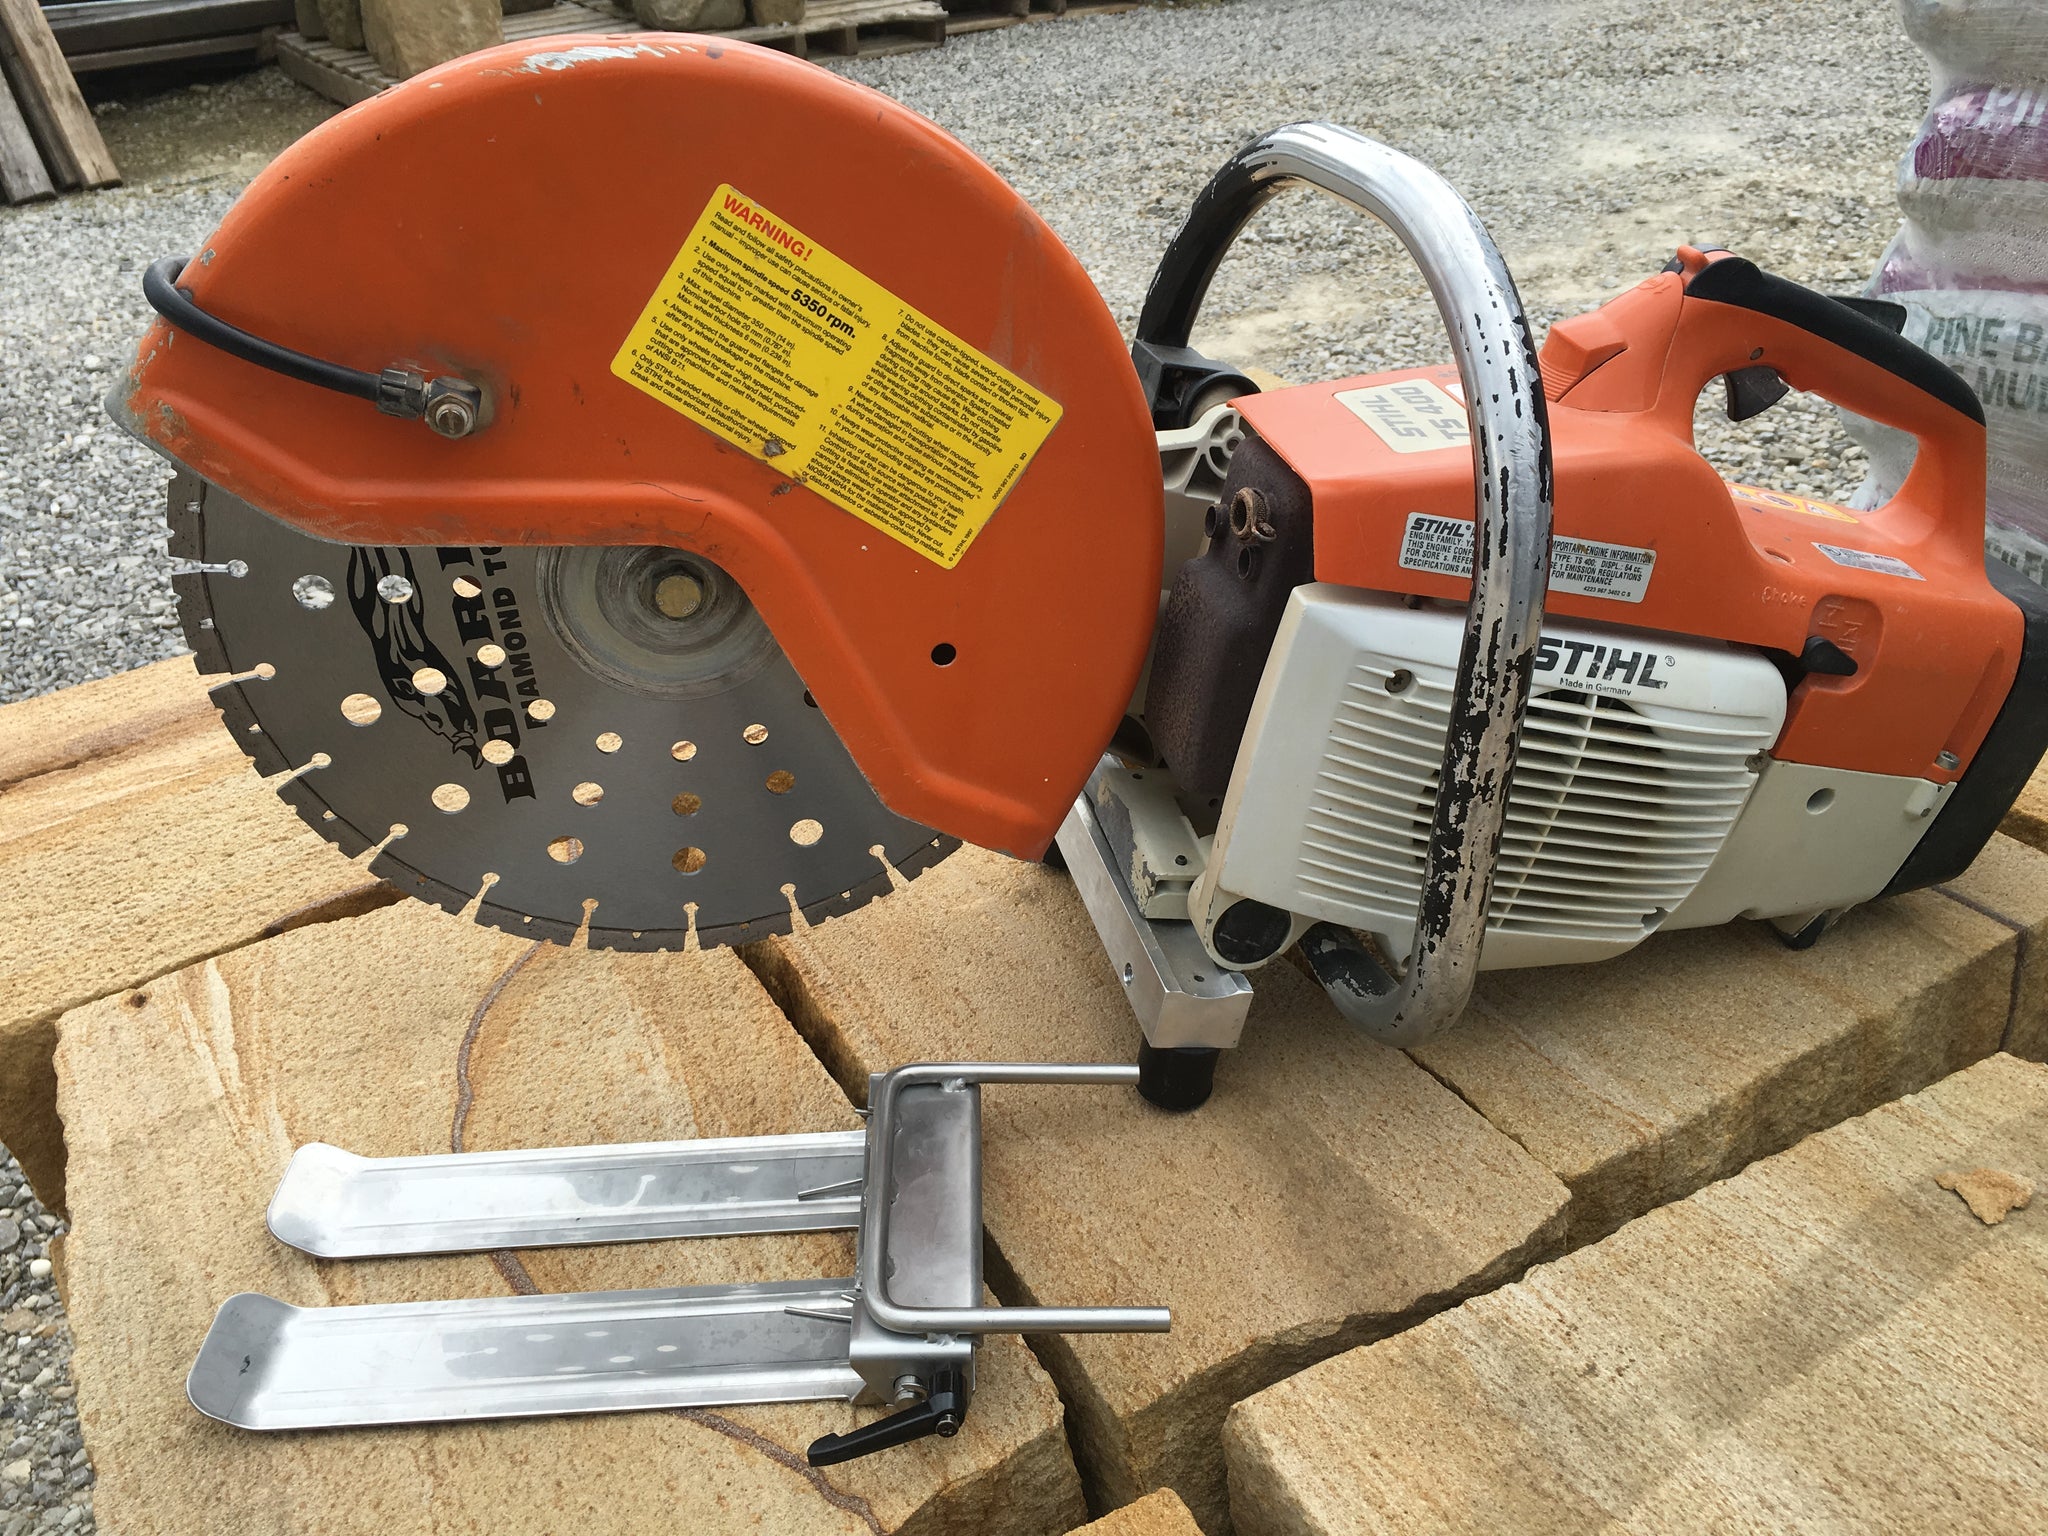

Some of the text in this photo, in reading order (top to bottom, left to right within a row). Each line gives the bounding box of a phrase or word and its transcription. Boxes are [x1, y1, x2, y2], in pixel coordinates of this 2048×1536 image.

[691, 265, 702, 275] of
[699, 270, 714, 283] this
[709, 219, 735, 239] manual
[737, 237, 768, 261] improper
[766, 257, 780, 269] use
[778, 265, 792, 277] can
[790, 273, 811, 289] cause
[809, 284, 834, 303] serious
[832, 299, 840, 308] or
[839, 303, 855, 317] fatal
[713, 210, 864, 312] Read and follow all safety precautions in owner's
[680, 283, 710, 306] Nominal
[708, 300, 728, 317] arbor
[725, 312, 742, 326] hole
[740, 321, 751, 331] 20
[749, 328, 763, 340] mm
[696, 258, 845, 356] speed equal to or greater than the spindle speed
[701, 250, 716, 264] Use
[714, 259, 731, 274] only
[729, 268, 754, 288] wheels
[752, 283, 779, 303] marked
[777, 299, 792, 312] with
[790, 308, 823, 332] maximum
[821, 328, 853, 352] operating
[707, 239, 743, 266] Maximum
[741, 261, 769, 283] spindle
[766, 278, 790, 296] speed
[789, 287, 828, 318] 5350
[824, 312, 857, 339] rpm.
[692, 302, 714, 319] wheel
[712, 314, 744, 338] thickness
[743, 333, 750, 341] 6
[748, 337, 762, 349] mm
[701, 287, 723, 304] wheel
[721, 299, 752, 321] diameter
[750, 317, 765, 329] 350
[762, 326, 777, 337] mm
[775, 333, 787, 344] (14
[644, 343, 655, 351] of
[652, 347, 672, 362] ANSI
[664, 310, 683, 324] after
[680, 320, 695, 333] any
[693, 327, 715, 344] wheel
[712, 339, 745, 363] breakage
[743, 358, 753, 368] on
[752, 363, 765, 374] the
[668, 302, 694, 322] Always
[692, 316, 719, 337] inspect
[717, 332, 730, 343] the
[728, 338, 750, 356] guard
[747, 351, 762, 363] and
[760, 358, 785, 378] flanges
[783, 372, 795, 383] for
[792, 379, 819, 399] damage
[904, 313, 915, 324] Do
[913, 320, 926, 331] not
[924, 327, 937, 338] use
[978, 363, 1018, 392] wood-cutting
[1015, 387, 1024, 395] or
[1022, 391, 1040, 406] metal
[1923, 315, 2048, 366] PINE B
[887, 337, 909, 355] Adjust
[907, 350, 919, 361] the
[917, 357, 937, 373] guard
[935, 368, 944, 377] to
[942, 372, 961, 388] direct
[958, 383, 980, 400] sparks
[978, 396, 992, 407] and
[989, 403, 1014, 422] material
[1976, 366, 2048, 413] MUL
[1360, 395, 1428, 437] STIHL
[1390, 387, 1470, 440] TS 400
[1408, 539, 1424, 549] THIS
[1426, 542, 1452, 553] ENGINE
[1409, 531, 1435, 542] ENGINE
[1437, 535, 1464, 546] FAMILY:
[1410, 517, 1464, 537] STIHL
[1403, 556, 1472, 575] SPECIFICATIONS AN
[1405, 547, 1420, 557] FOR
[1555, 553, 1573, 563] TYPE:
[1574, 556, 1583, 565] TS
[1565, 564, 1595, 575] EMISSION
[1598, 569, 1642, 582] REGULATIONS
[1586, 546, 1609, 557] ENGINE
[1610, 549, 1654, 564] INFORMATION
[1551, 570, 1613, 586] FOR MAINTENANCE
[1534, 636, 1668, 689] STIHL
[1559, 677, 1583, 688] Made
[1585, 681, 1593, 690] in
